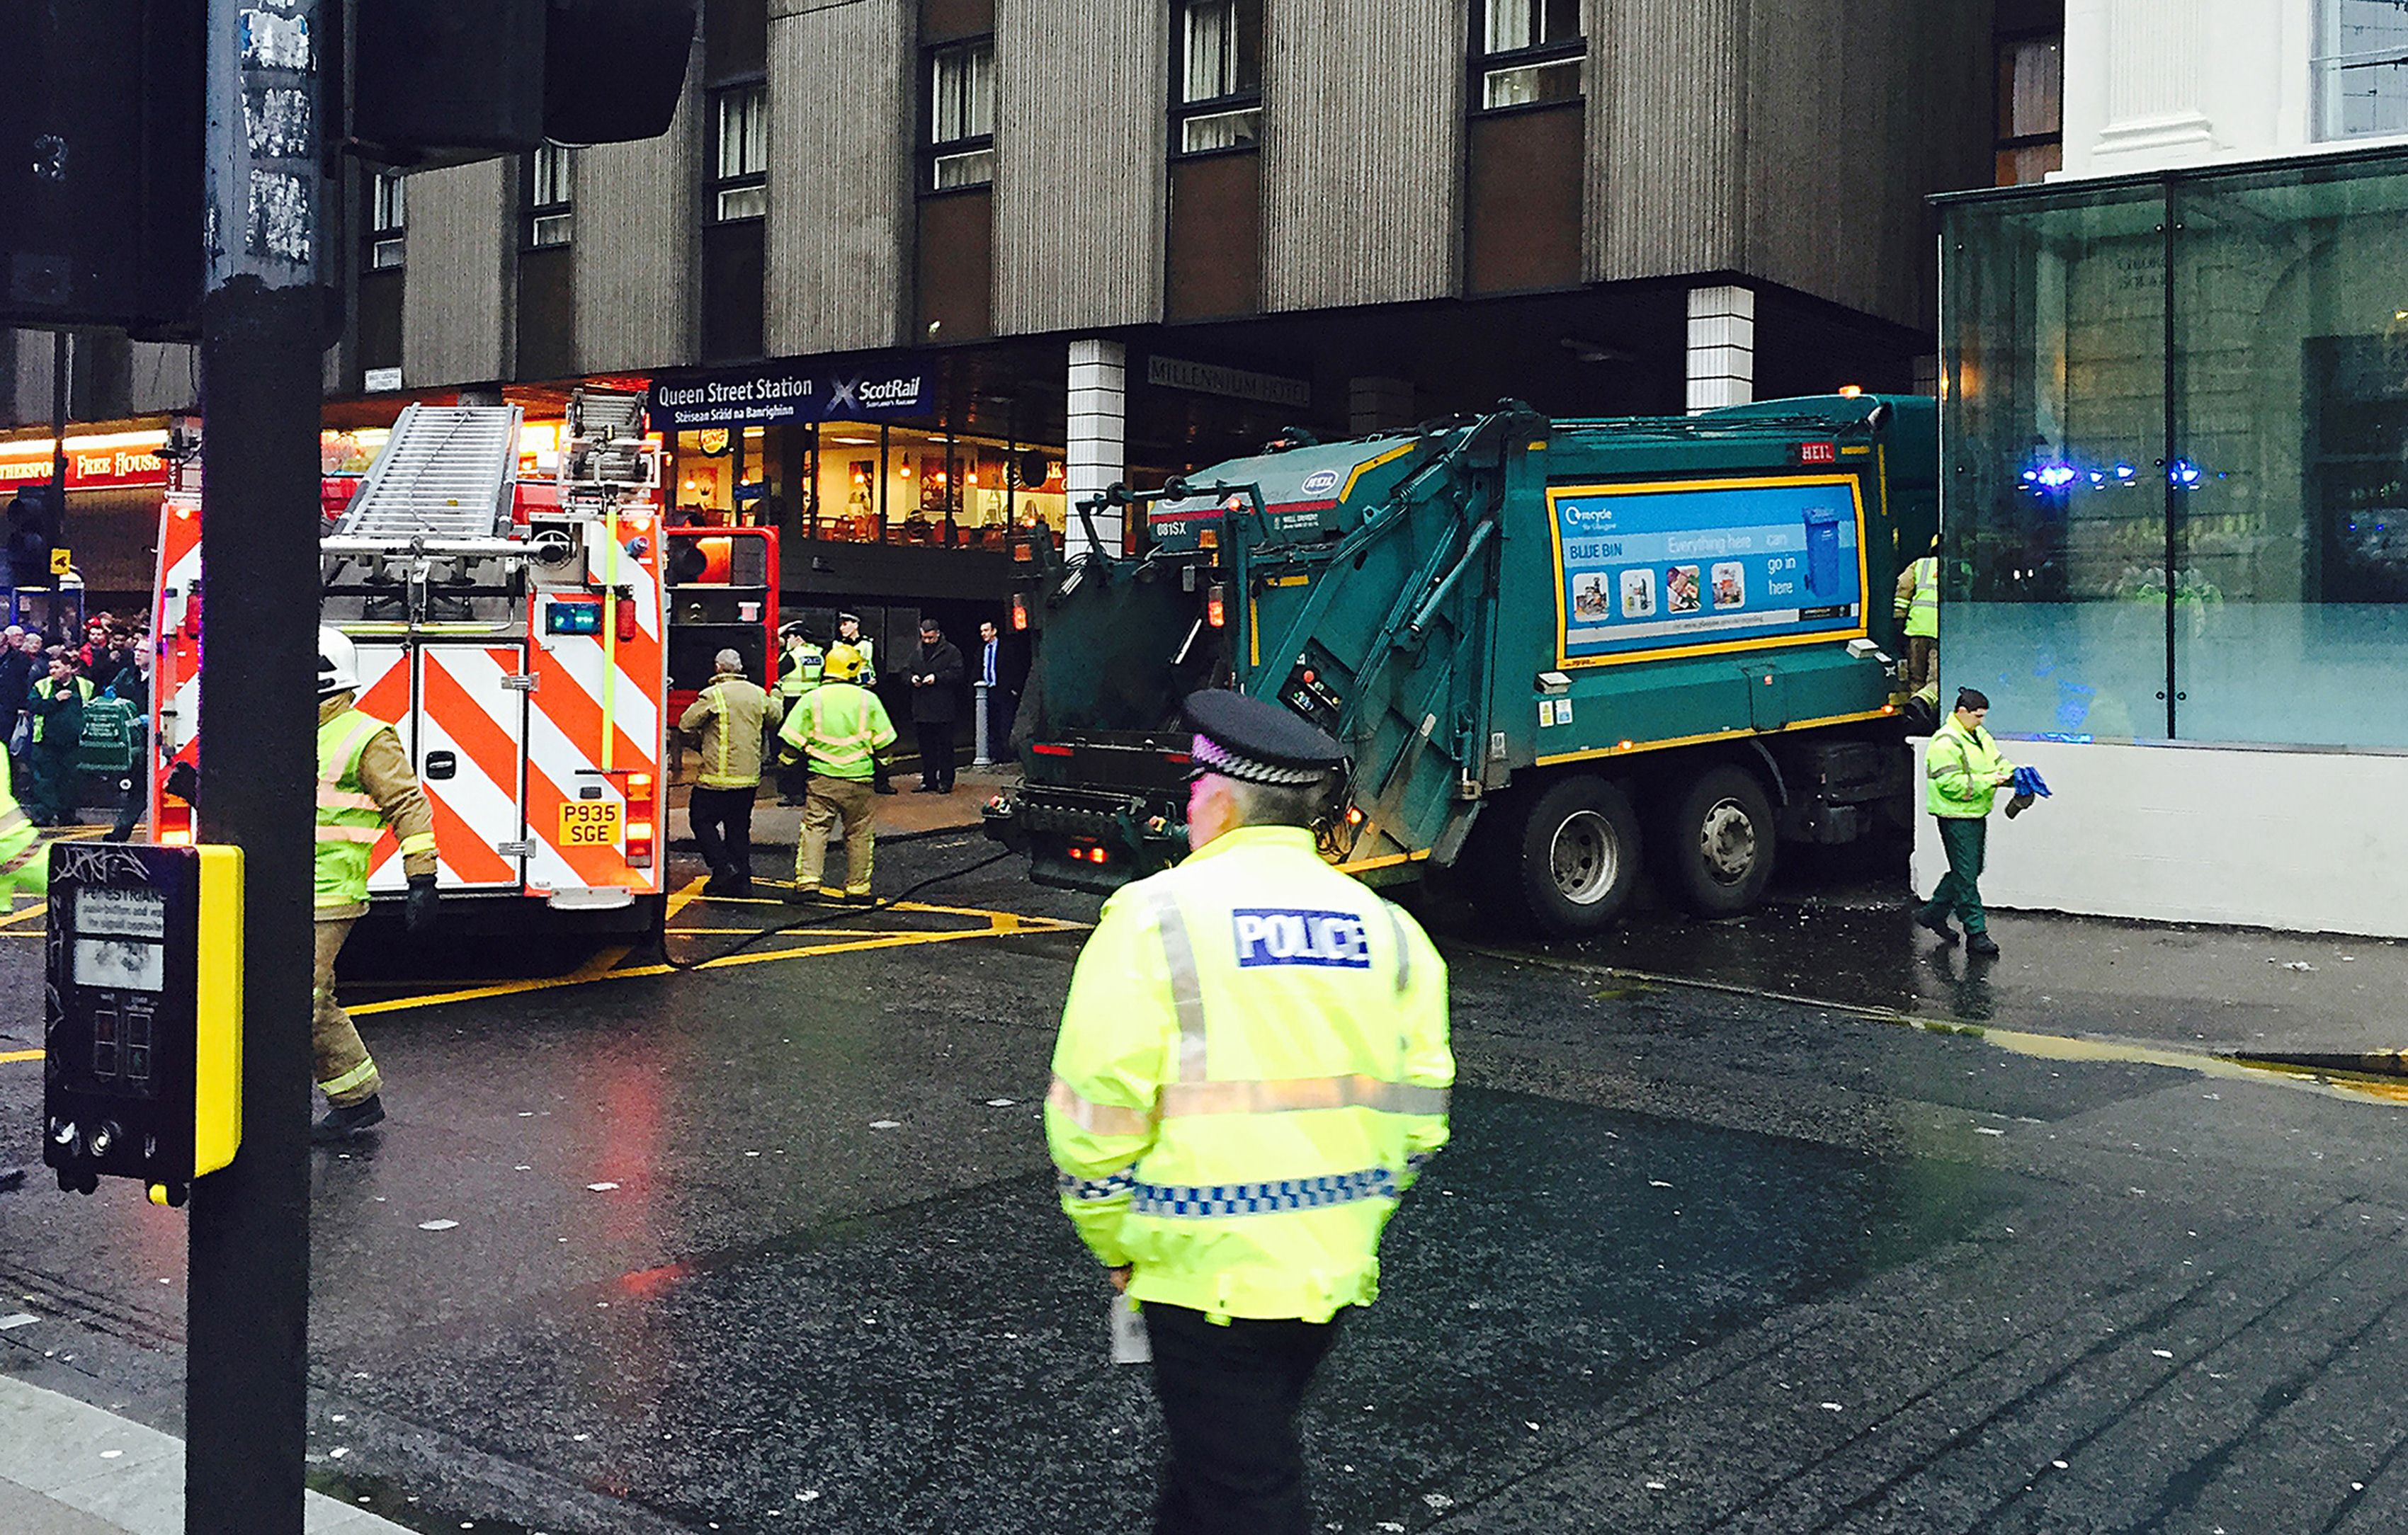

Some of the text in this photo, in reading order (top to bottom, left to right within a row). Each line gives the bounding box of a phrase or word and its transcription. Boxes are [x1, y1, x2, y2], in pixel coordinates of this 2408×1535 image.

[659, 376, 812, 406] Queen Street Station
[858, 376, 921, 401] ScotRail
[1802, 445, 1833, 460] HEIL
[1570, 533, 1788, 559] BLUE BIN Everything here can
[1768, 554, 1796, 576] go in
[1768, 579, 1794, 595] here
[564, 804, 616, 823] P935
[571, 825, 609, 843] SGE
[1235, 914, 1368, 961] POLICE
